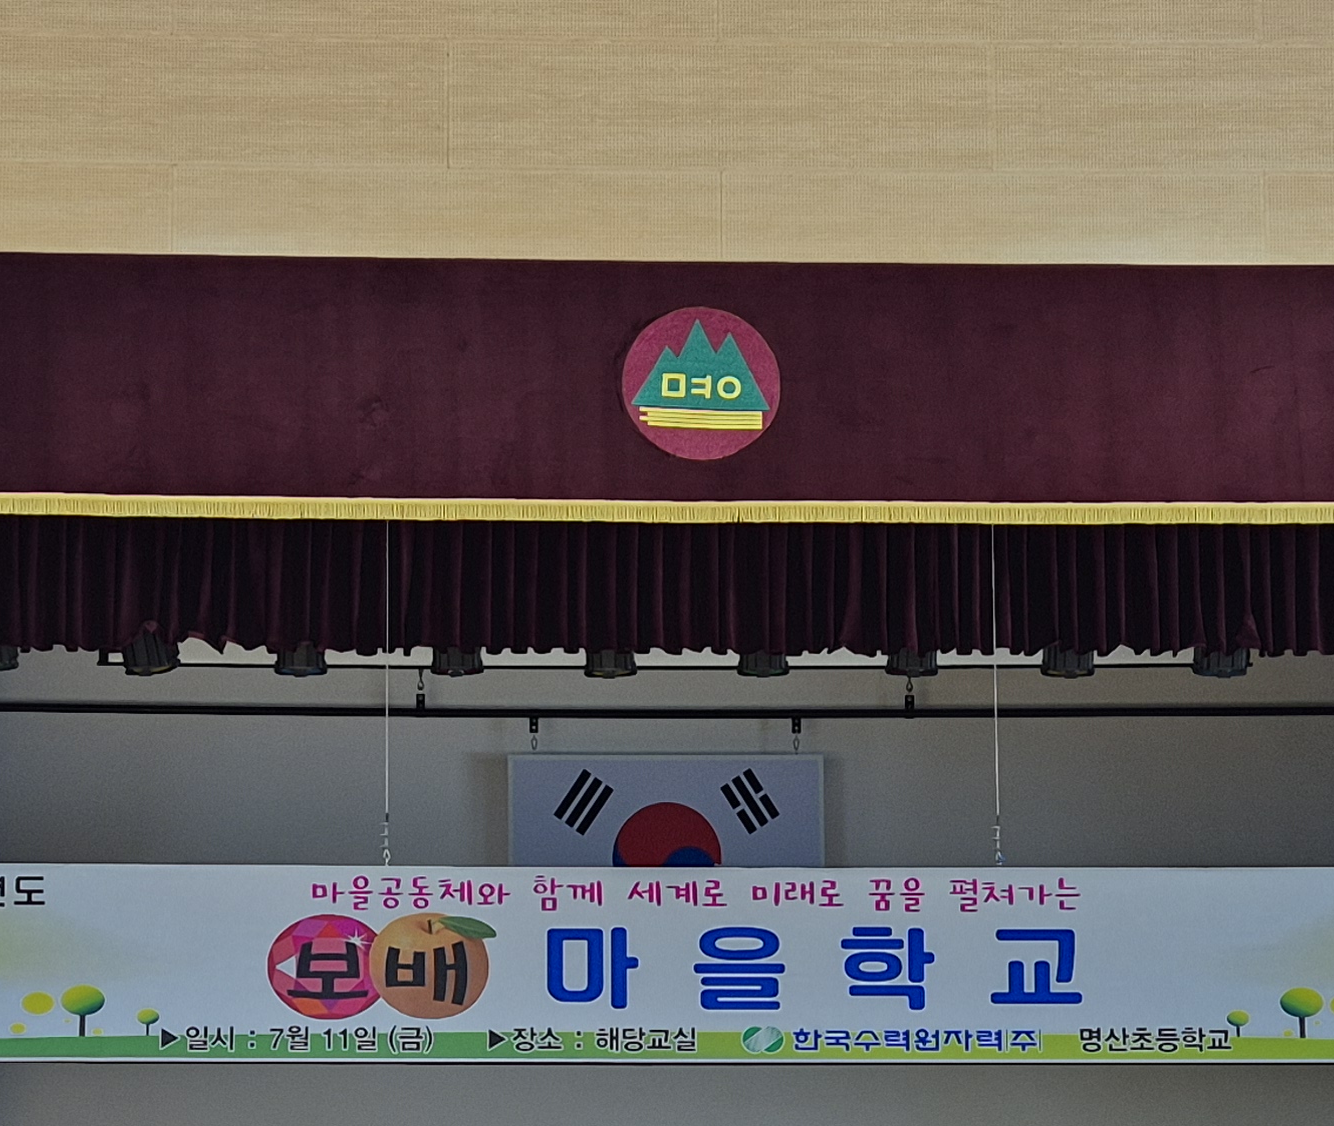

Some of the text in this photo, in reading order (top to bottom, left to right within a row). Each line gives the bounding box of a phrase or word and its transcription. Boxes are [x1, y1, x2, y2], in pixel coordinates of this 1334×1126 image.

[312, 875, 1081, 912] 마을공동체와 함께 세계로 미래로 꿈을 펼쳐가는
[287, 941, 468, 1006] 보배
[186, 1026, 234, 1050] 일시
[269, 1026, 310, 1050] 7월
[322, 1026, 377, 1051] 11일
[388, 1025, 434, 1053] (금)
[513, 1028, 562, 1051] 장소
[596, 1027, 697, 1051] 해당교실
[1079, 1027, 1232, 1053] 명산초등학교
